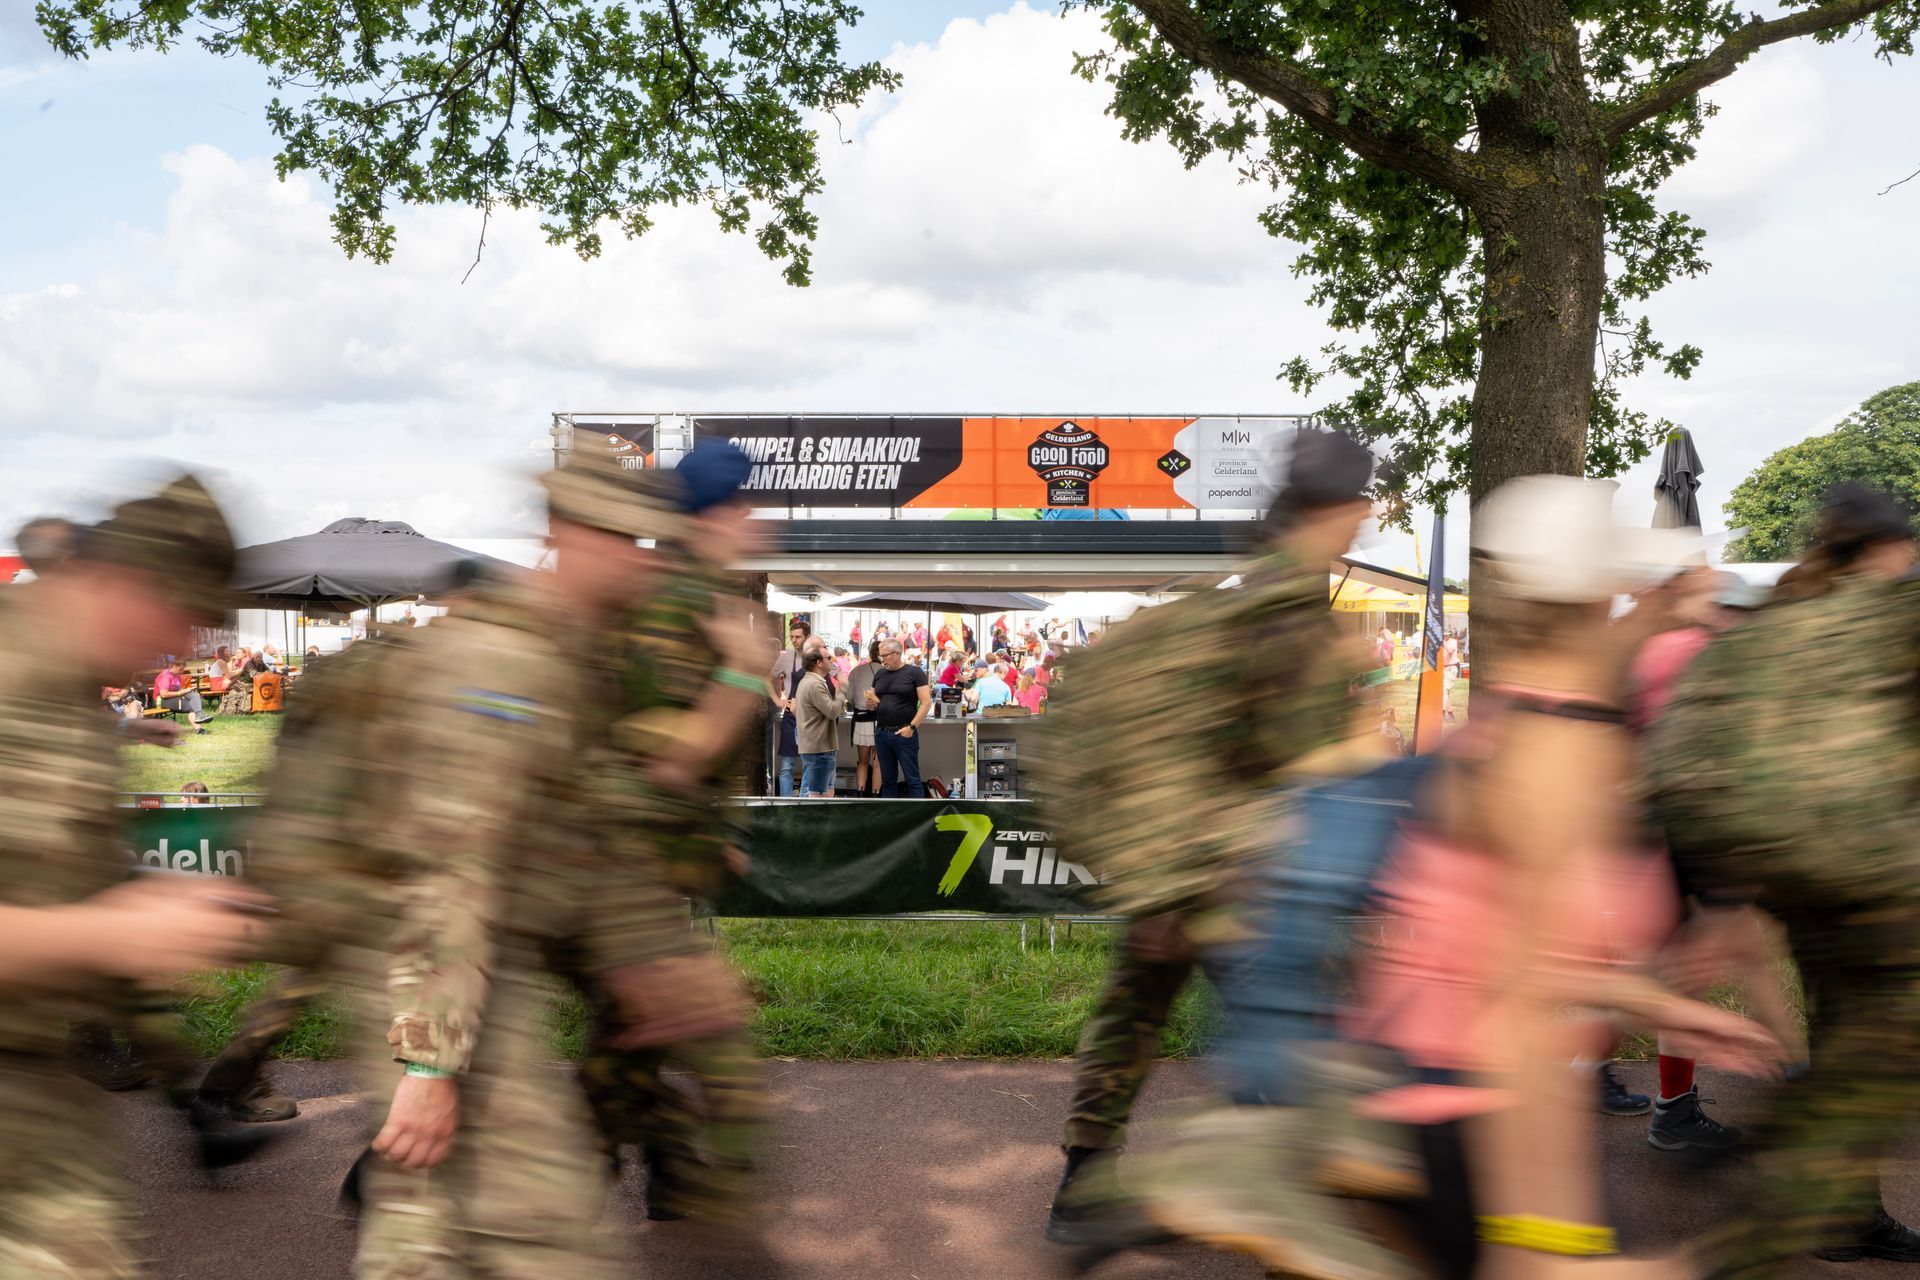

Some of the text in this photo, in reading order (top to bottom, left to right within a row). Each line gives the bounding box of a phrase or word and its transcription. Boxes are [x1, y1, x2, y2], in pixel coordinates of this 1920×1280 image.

[1045, 432, 1092, 443] GELDERLAND
[799, 437, 814, 463] &
[815, 437, 921, 463] SMAAKVOL
[1031, 447, 1068, 466] GOOD
[1218, 460, 1247, 468] provincie
[855, 464, 902, 490] ETEN
[1052, 469, 1085, 478] KITCHEN
[1214, 467, 1258, 476] Gelderland
[1208, 487, 1252, 499] papendal
[934, 813, 994, 898] 7
